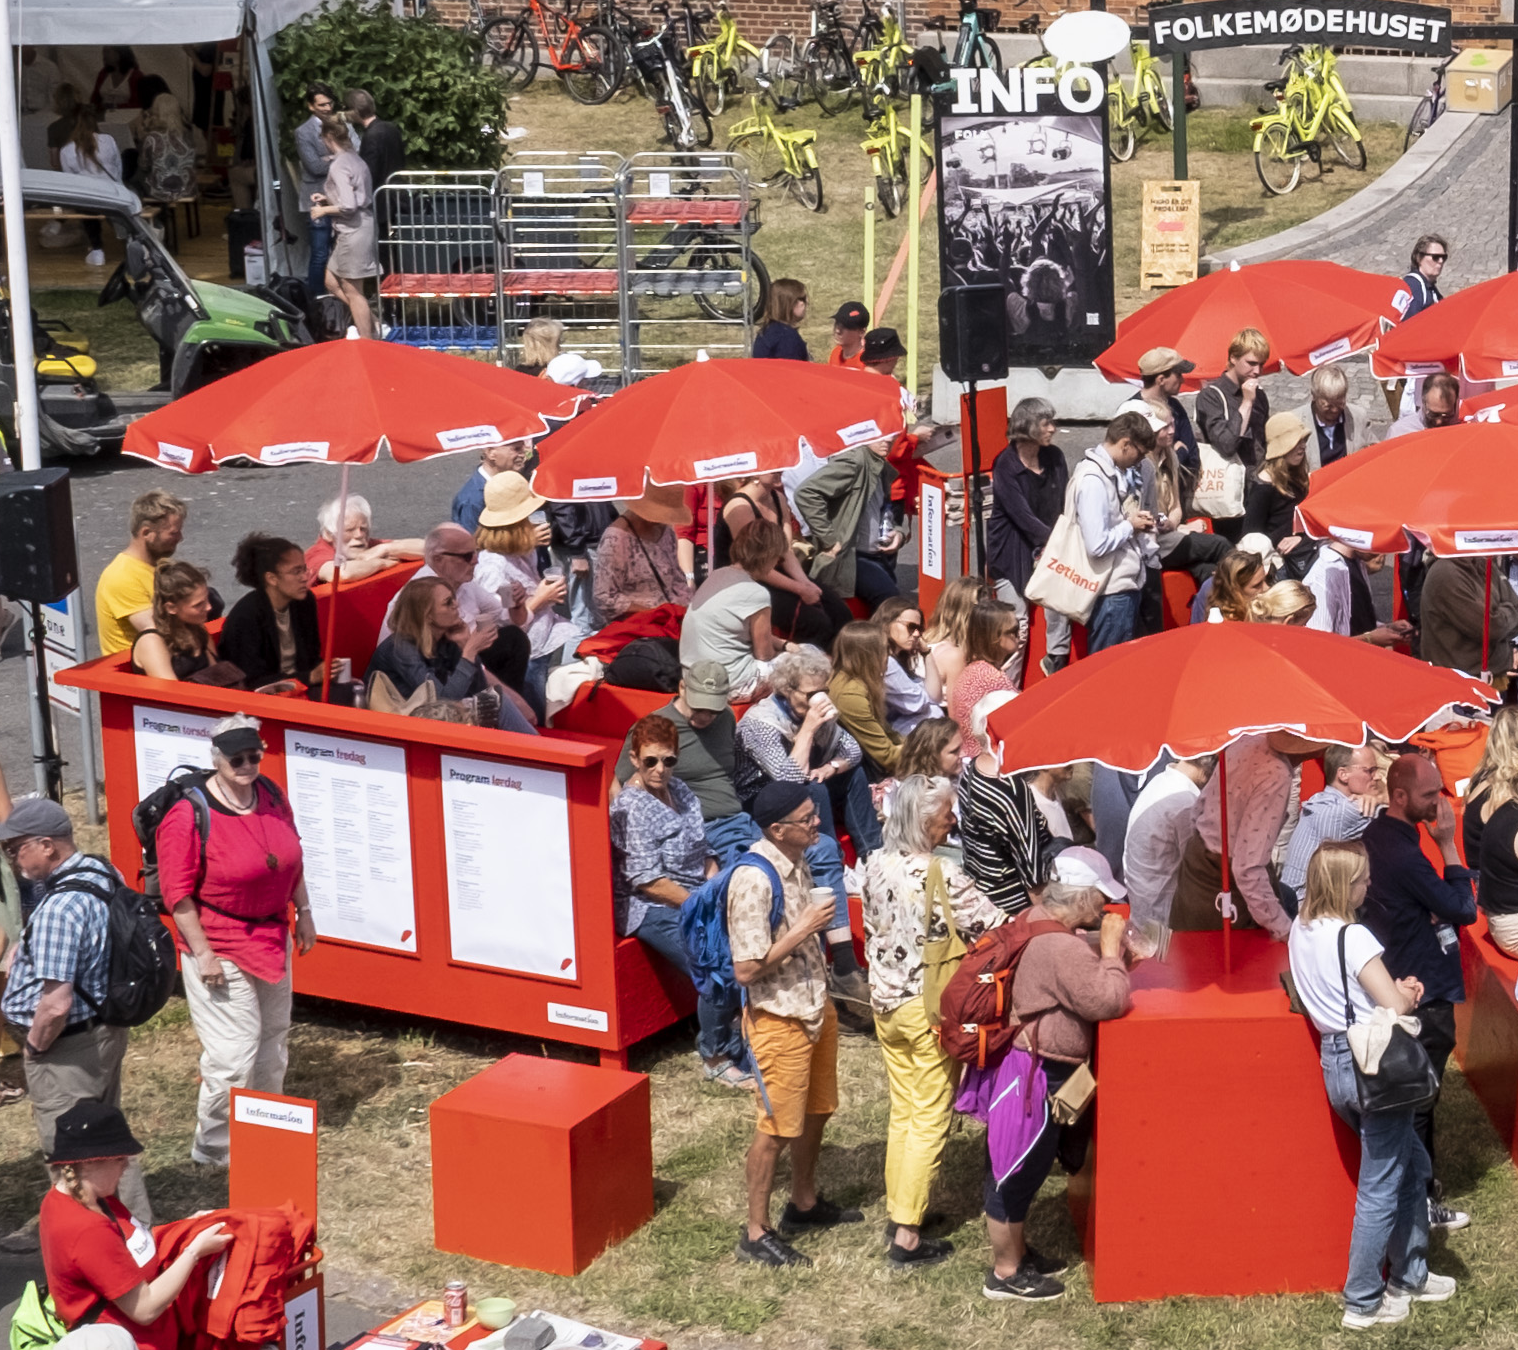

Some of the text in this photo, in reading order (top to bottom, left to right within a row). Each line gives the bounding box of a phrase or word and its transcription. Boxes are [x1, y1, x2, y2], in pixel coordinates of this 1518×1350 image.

[1153, 8, 1447, 45] FOLKEMØDEHUSET
[952, 67, 1105, 114] INFO
[954, 129, 989, 140] FOLK
[1047, 557, 1100, 593] zetland
[142, 718, 211, 738] Program torsd
[294, 742, 366, 765] Program fredag
[449, 768, 522, 792] Program lørdag
[555, 1010, 599, 1026] Information
[246, 1106, 303, 1125] Information
